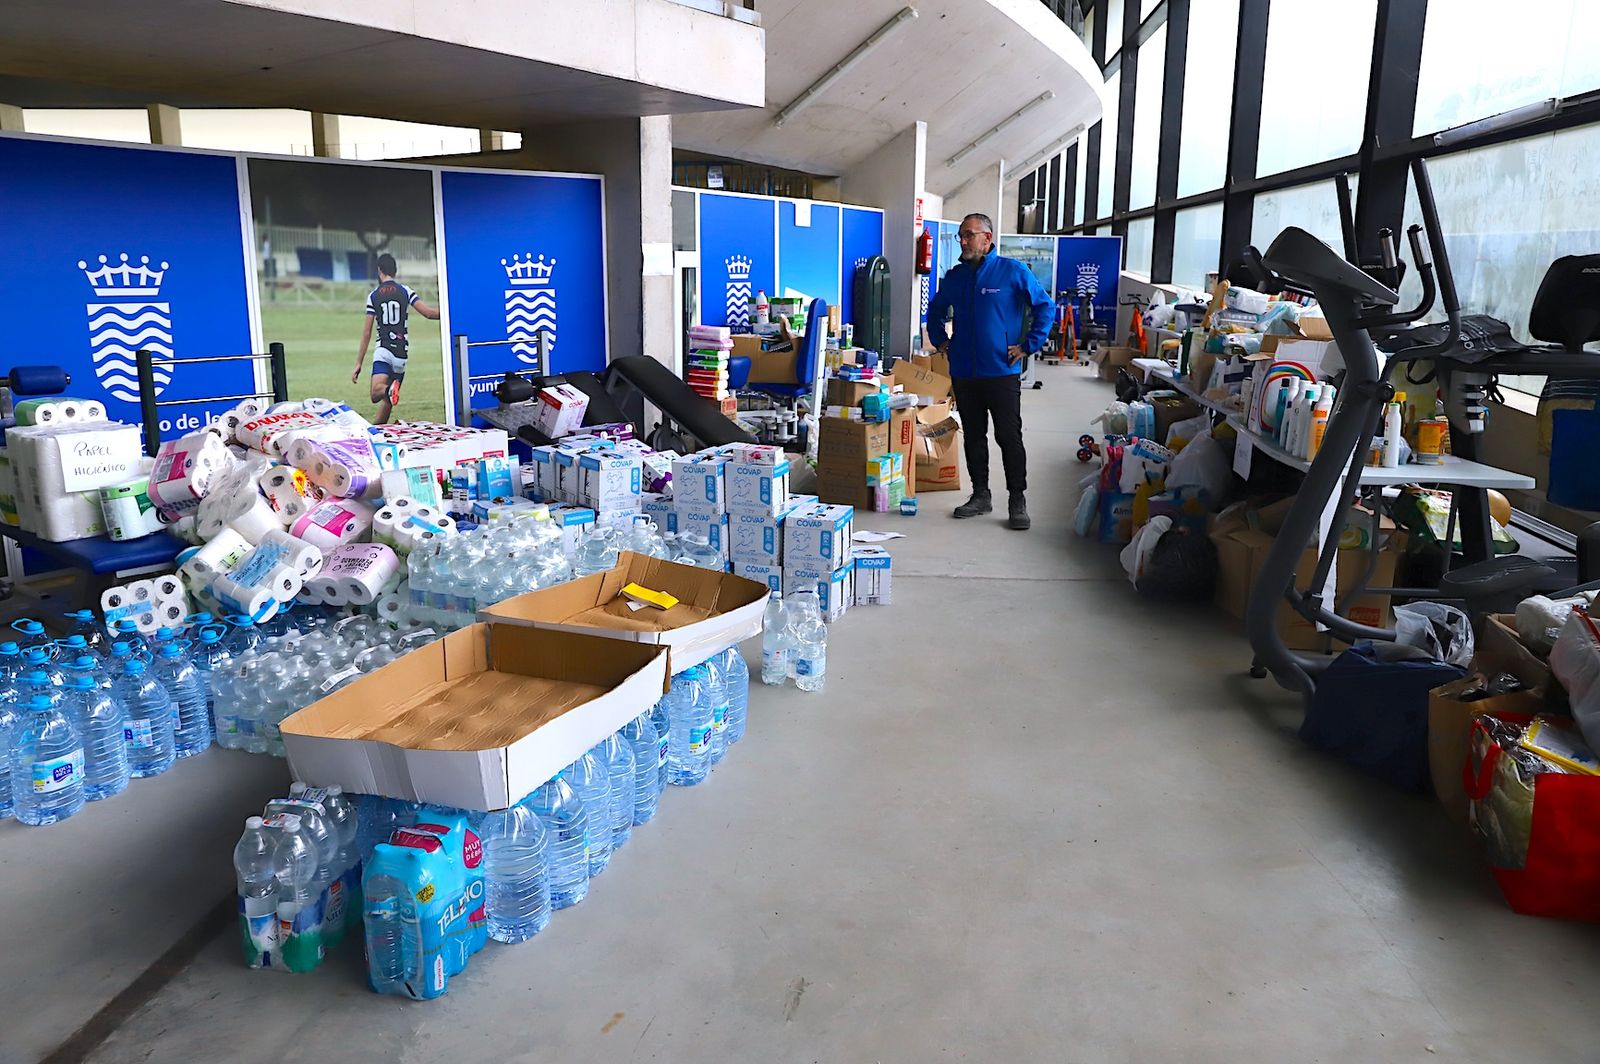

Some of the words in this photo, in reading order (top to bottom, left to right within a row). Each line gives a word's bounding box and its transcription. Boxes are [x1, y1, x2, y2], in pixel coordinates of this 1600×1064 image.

[381, 300, 400, 325] 10
[176, 416, 200, 430] de
[74, 442, 111, 457] PAPEL
[610, 460, 633, 468] COVAP
[682, 466, 707, 474] COVAP
[736, 467, 762, 476] COVAP
[645, 503, 669, 511] COVAP
[687, 513, 710, 522] COVAP
[740, 515, 765, 524] COVAP
[796, 519, 822, 528] COVAP
[745, 565, 770, 574] COVAP
[794, 570, 820, 579] COVAP
[465, 839, 481, 854] MUY
